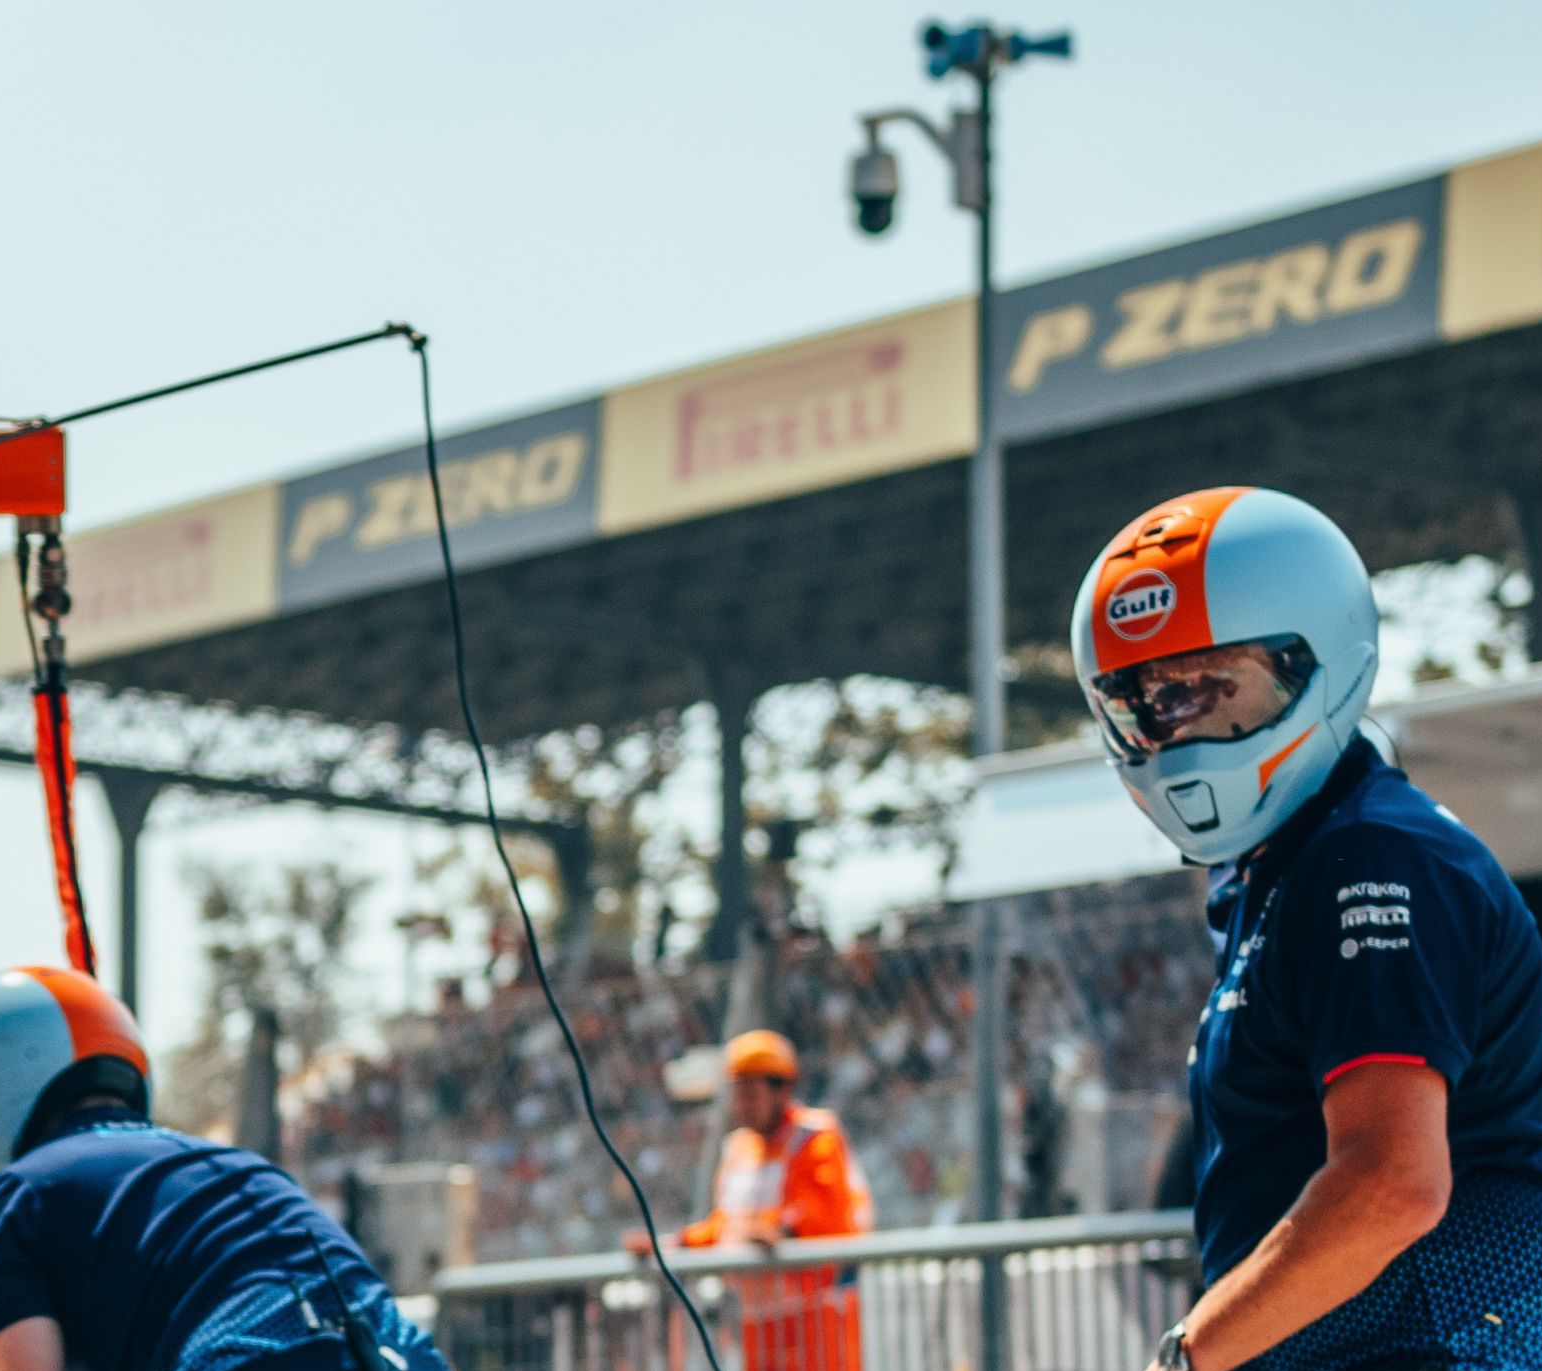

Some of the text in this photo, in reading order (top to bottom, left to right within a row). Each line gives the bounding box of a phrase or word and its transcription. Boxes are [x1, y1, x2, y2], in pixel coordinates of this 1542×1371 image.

[1008, 219, 1424, 393] P ZERO
[290, 433, 588, 564] P ZERO
[1108, 588, 1172, 620] Gulf
